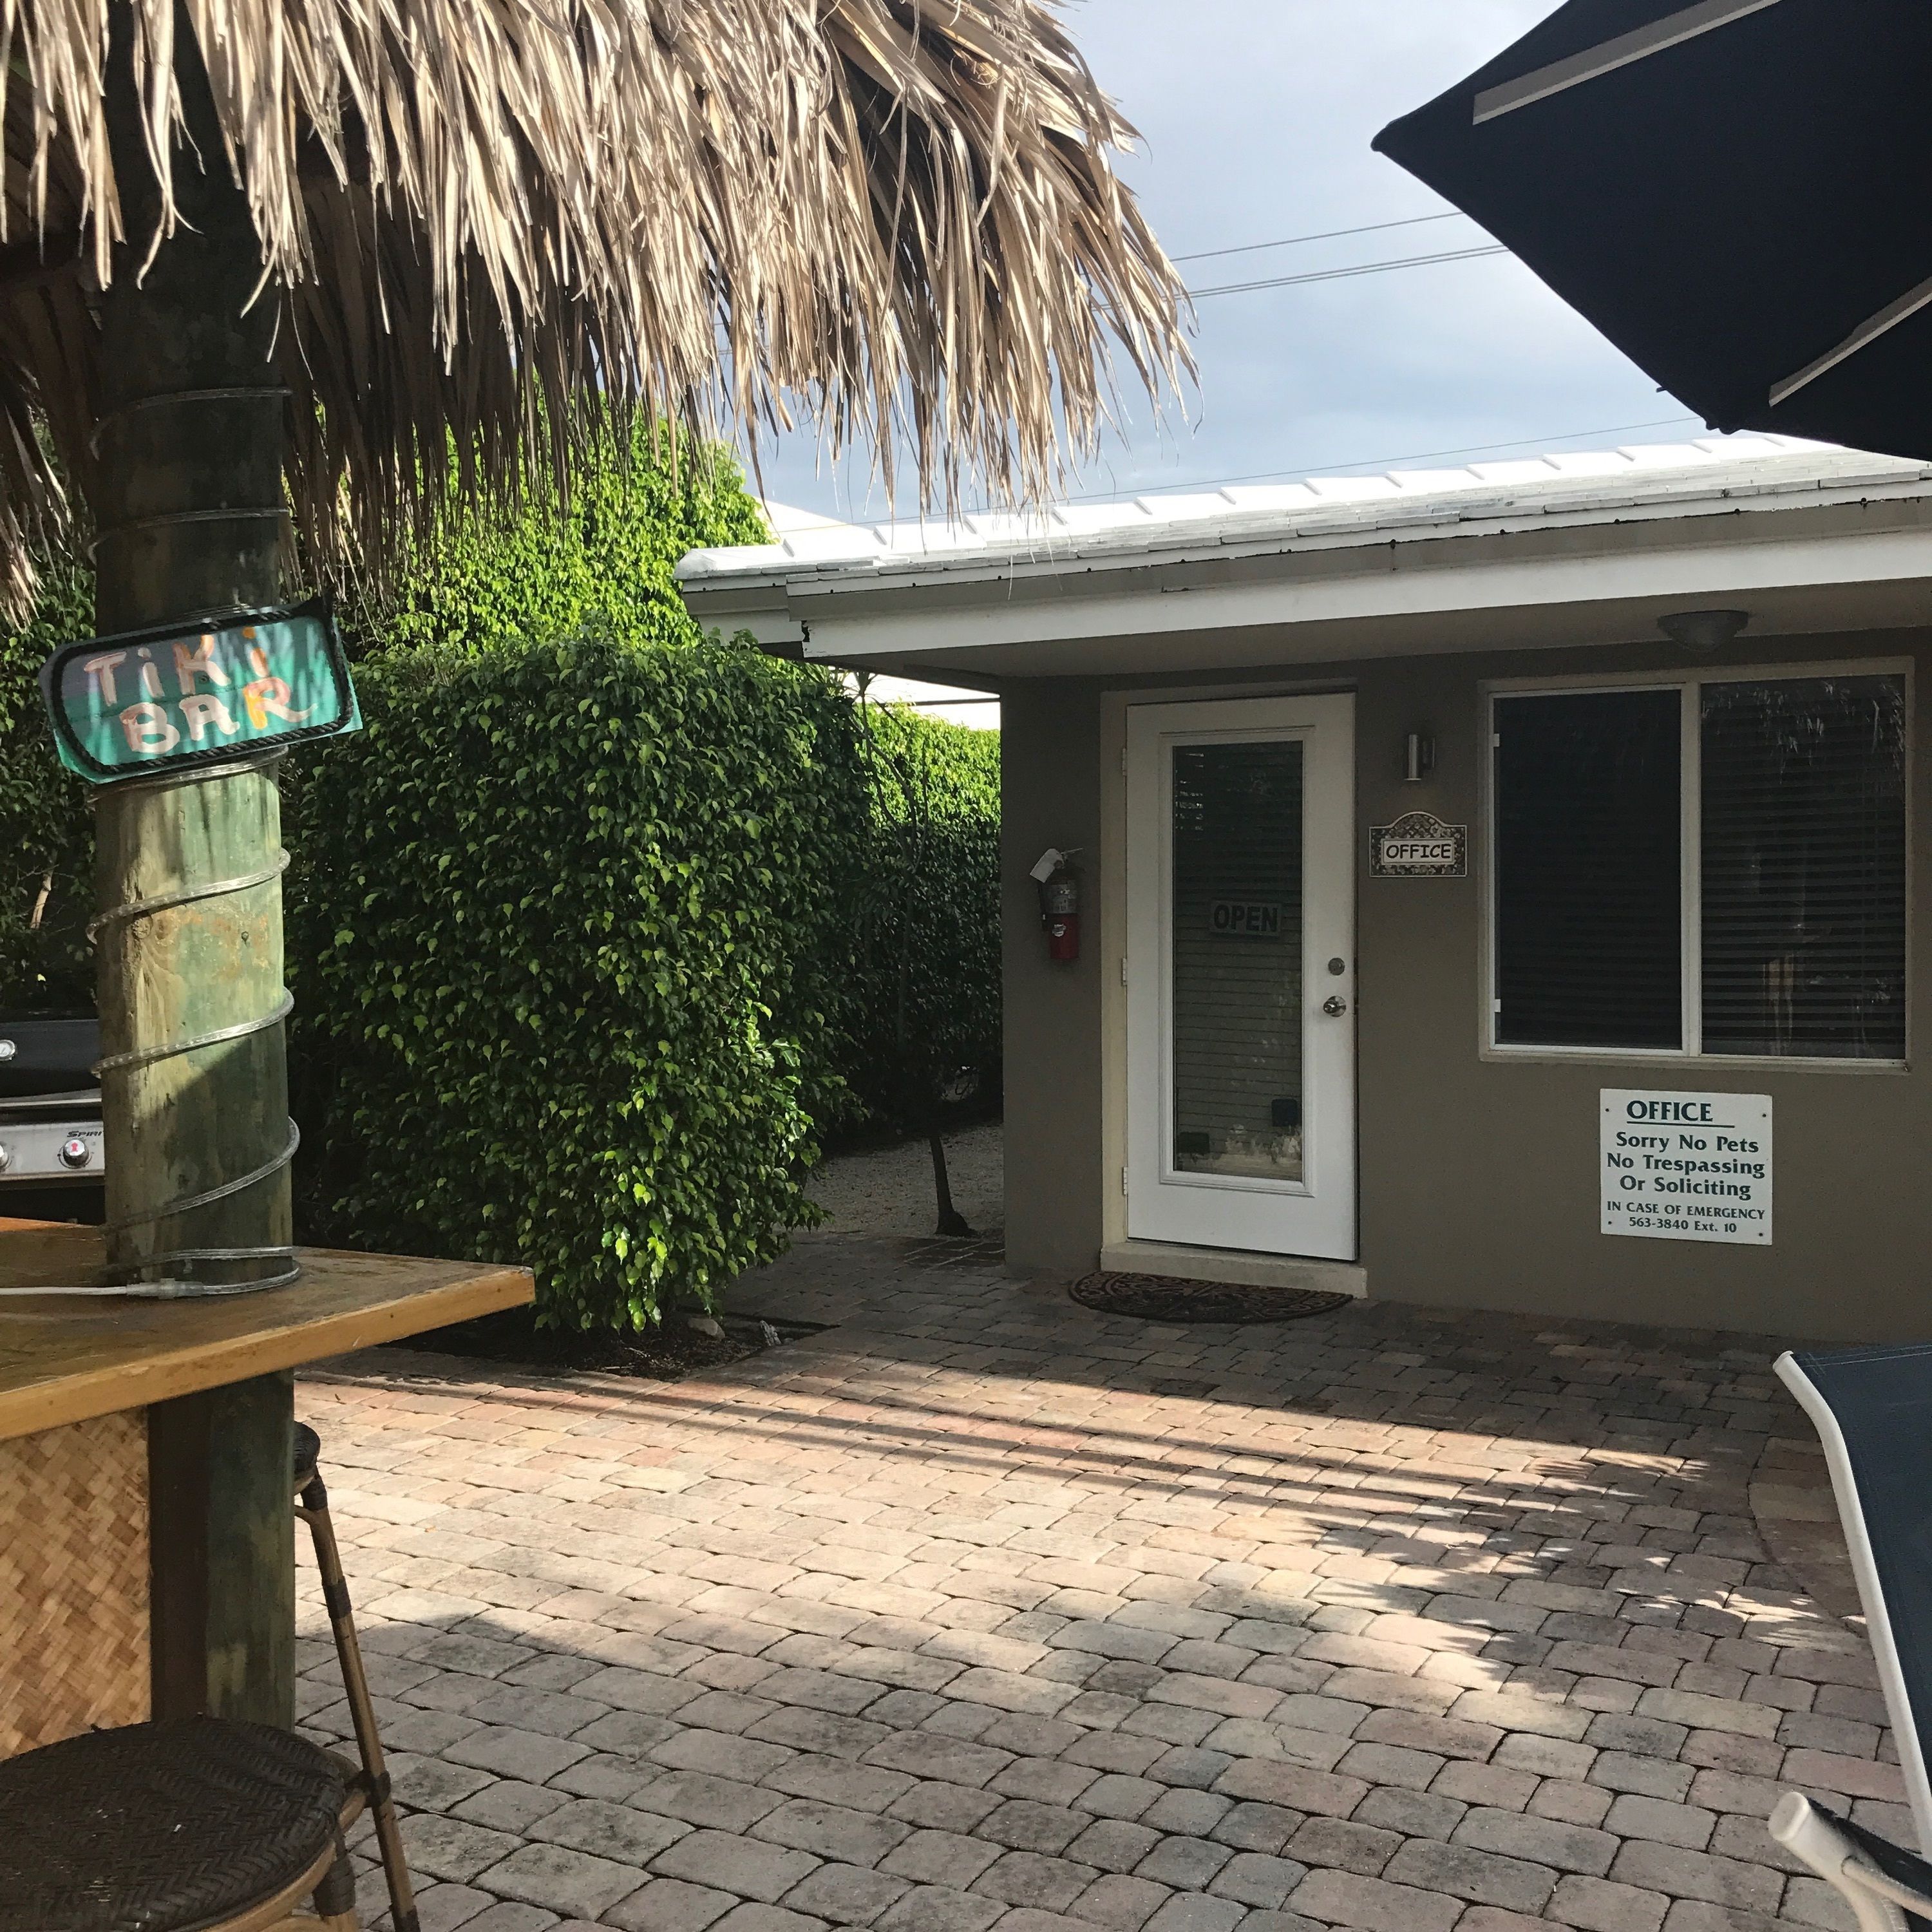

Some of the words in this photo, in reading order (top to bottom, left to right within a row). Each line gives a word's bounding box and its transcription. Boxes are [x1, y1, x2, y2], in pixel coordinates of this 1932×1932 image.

[84, 627, 269, 706] TiKi
[119, 676, 318, 754] BAR
[1386, 844, 1452, 860] OFFICE
[1213, 904, 1278, 932] OPEN
[1627, 1100, 1713, 1122] OFFICE
[1616, 1132, 1670, 1153] Sorry
[1679, 1135, 1707, 1151] No
[1716, 1136, 1759, 1153] Pets
[1607, 1153, 1634, 1168] No
[1642, 1155, 1765, 1179] Trespassing
[1620, 1175, 1646, 1191] Or
[1654, 1177, 1752, 1201] Soliciting
[1607, 1201, 1621, 1211] IN
[1626, 1202, 1659, 1214] CASE
[1664, 1205, 1682, 1215] OF
[1687, 1206, 1765, 1220] EMERGENCY
[1629, 1217, 1689, 1230] 563-3840
[1694, 1221, 1718, 1233] Ext.
[1724, 1223, 1737, 1233] 10
